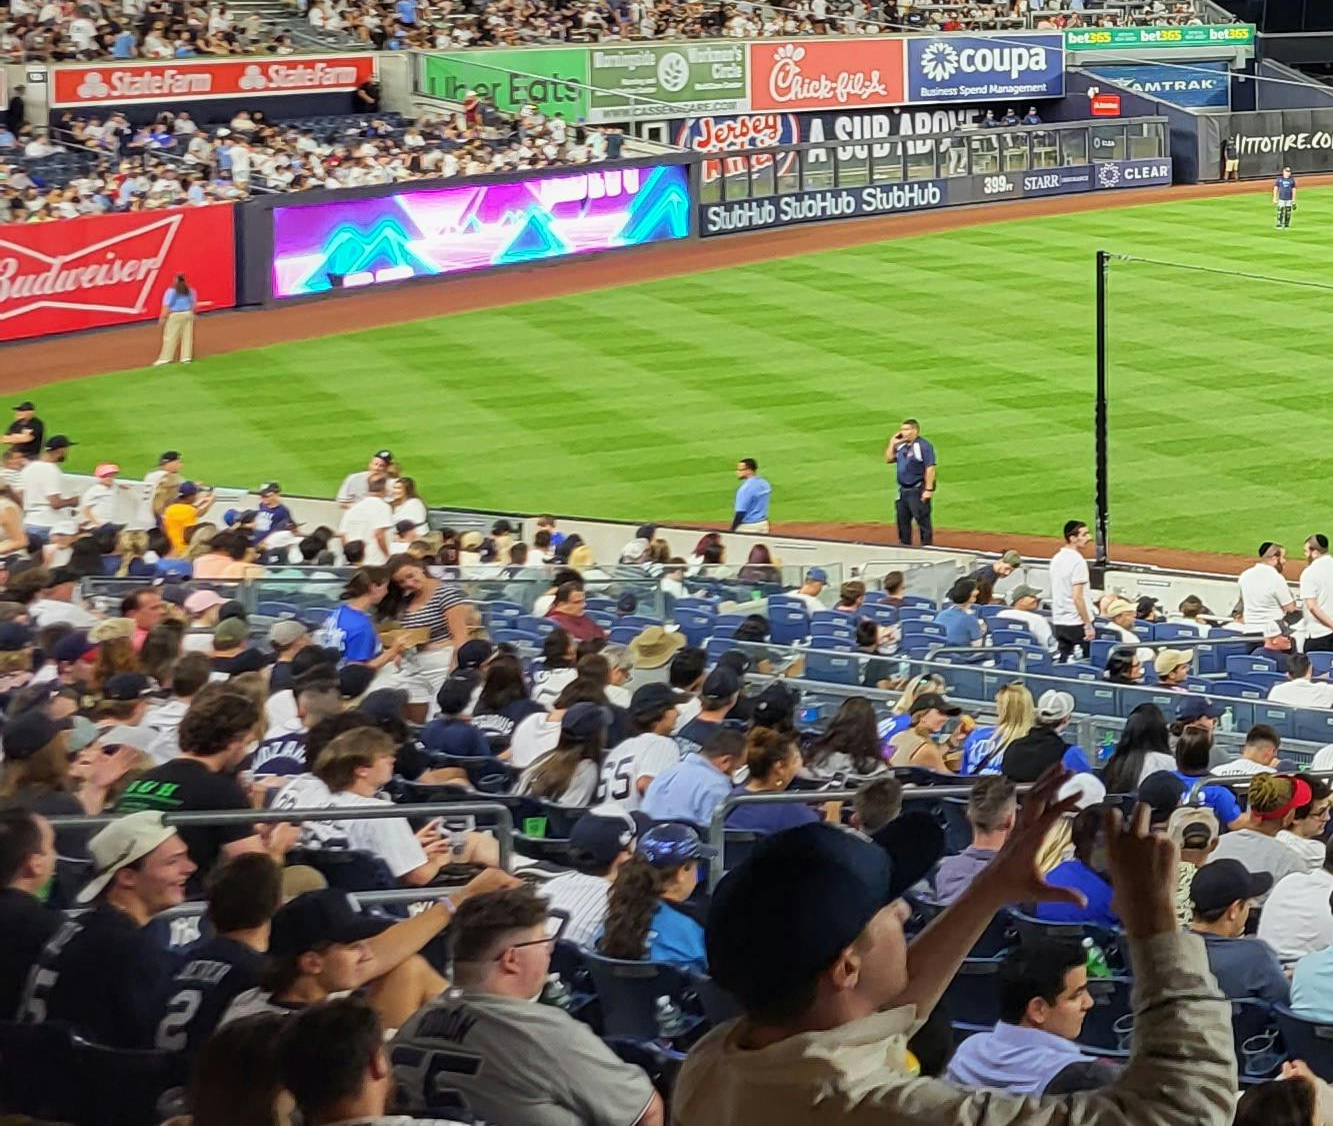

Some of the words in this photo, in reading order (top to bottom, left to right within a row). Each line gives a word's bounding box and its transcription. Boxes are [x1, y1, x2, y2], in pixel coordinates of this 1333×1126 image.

[1068, 32, 1112, 44] bet365
[1140, 29, 1182, 42] bet365
[1209, 28, 1249, 40] bet365
[959, 47, 1047, 80] coupa
[509, 73, 582, 106] Eats
[769, 57, 887, 103] Chick-fil-A
[920, 86, 956, 98] Business
[958, 84, 987, 97] Spend
[989, 83, 1047, 95] Management
[1132, 79, 1213, 92] AMTRAK
[696, 113, 782, 149] Jersey
[807, 118, 828, 164] A
[834, 114, 891, 161] SUB
[1024, 174, 1059, 190] STARR
[1124, 165, 1168, 179] CLEAR
[779, 195, 856, 221] StubHub
[861, 183, 942, 212] StubHub
[707, 203, 776, 232] StubHub
[154, 989, 204, 1051] 2
